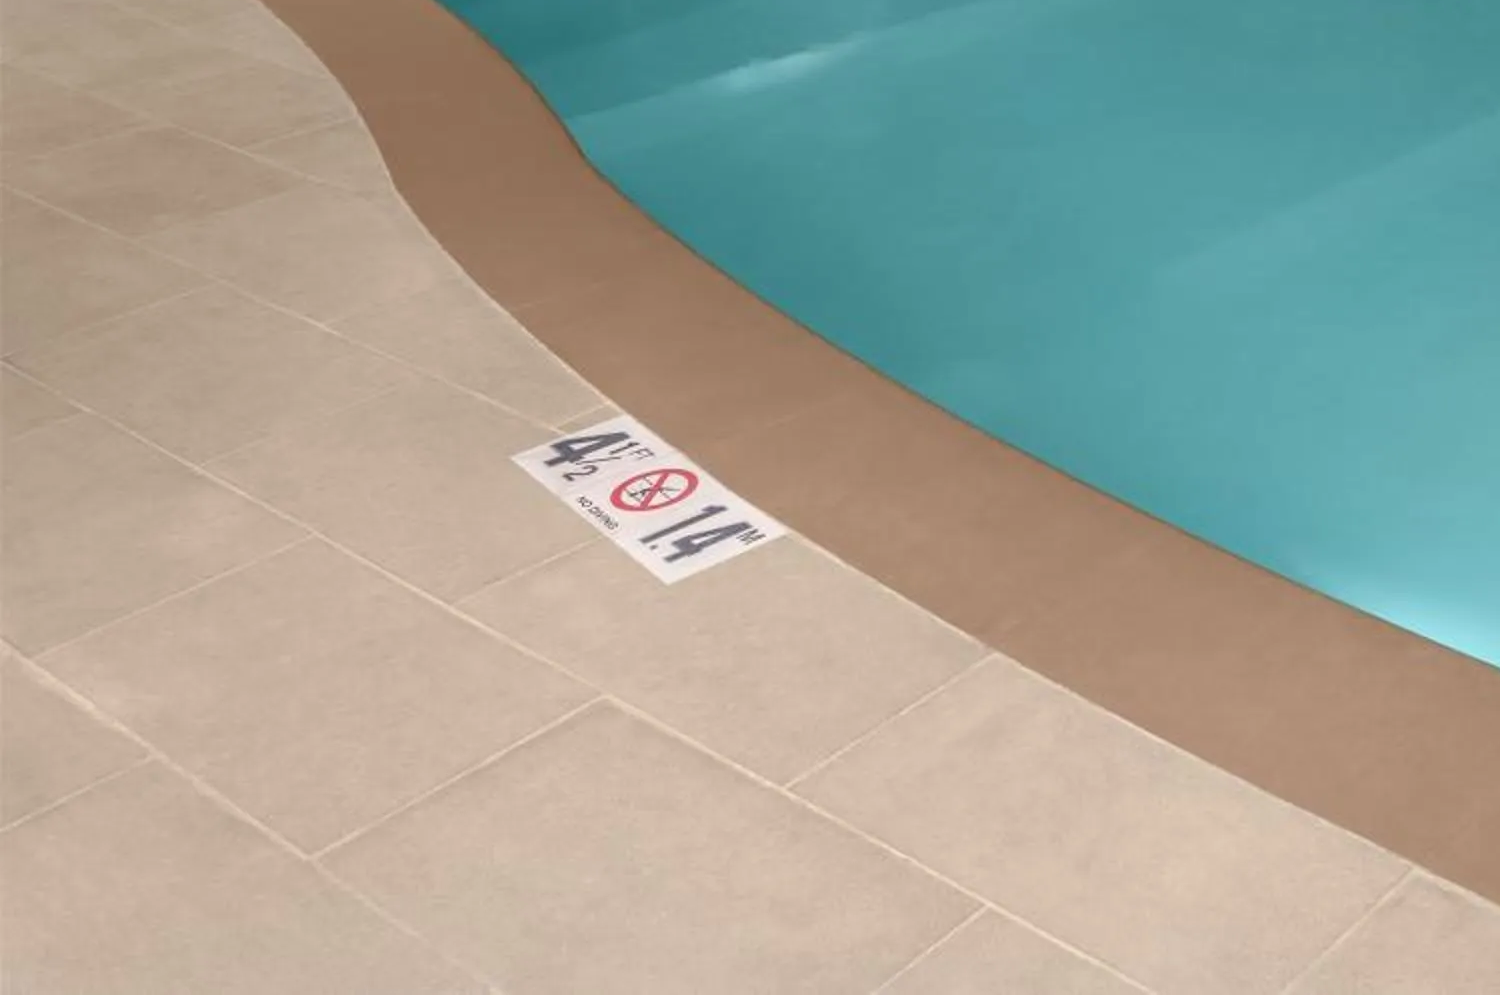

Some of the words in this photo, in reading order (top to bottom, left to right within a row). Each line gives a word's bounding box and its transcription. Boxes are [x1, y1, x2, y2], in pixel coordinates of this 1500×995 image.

[544, 431, 630, 467] 4
[587, 505, 619, 530] DIVING
[638, 505, 753, 563] 1.4
[736, 528, 767, 546] M
